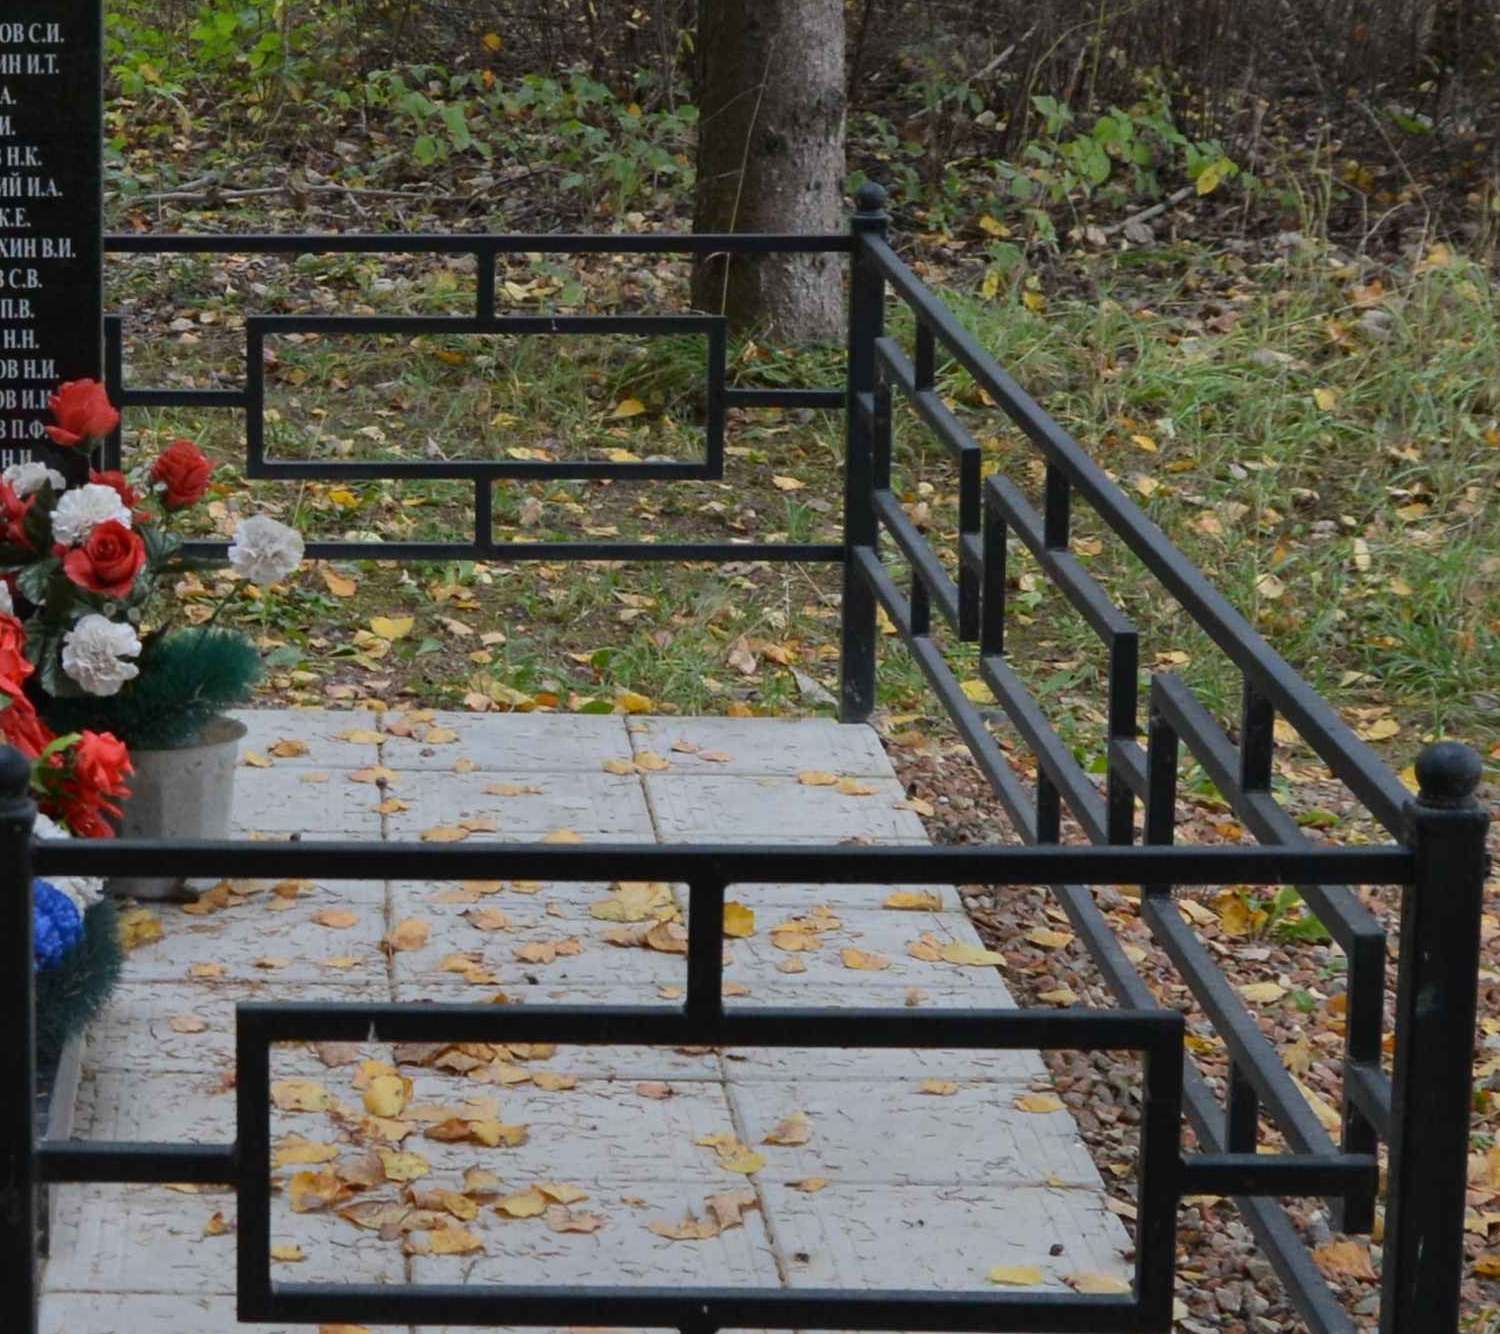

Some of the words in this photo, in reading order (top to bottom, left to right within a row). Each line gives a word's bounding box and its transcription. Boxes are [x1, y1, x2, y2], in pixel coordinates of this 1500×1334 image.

[29, 23, 64, 43] С.И.
[27, 54, 59, 74] И.Т.
[7, 147, 42, 166] Н.К.
[28, 177, 62, 197] И.А.
[42, 238, 76, 258] В.И.
[9, 269, 42, 288] С.В.
[1, 299, 34, 318] П.В.
[4, 329, 39, 349] Н.Н.
[24, 359, 59, 379] Н.И.
[22, 390, 51, 409] И.И
[12, 419, 48, 439] П.Ф.
[1, 450, 32, 468] НИ
